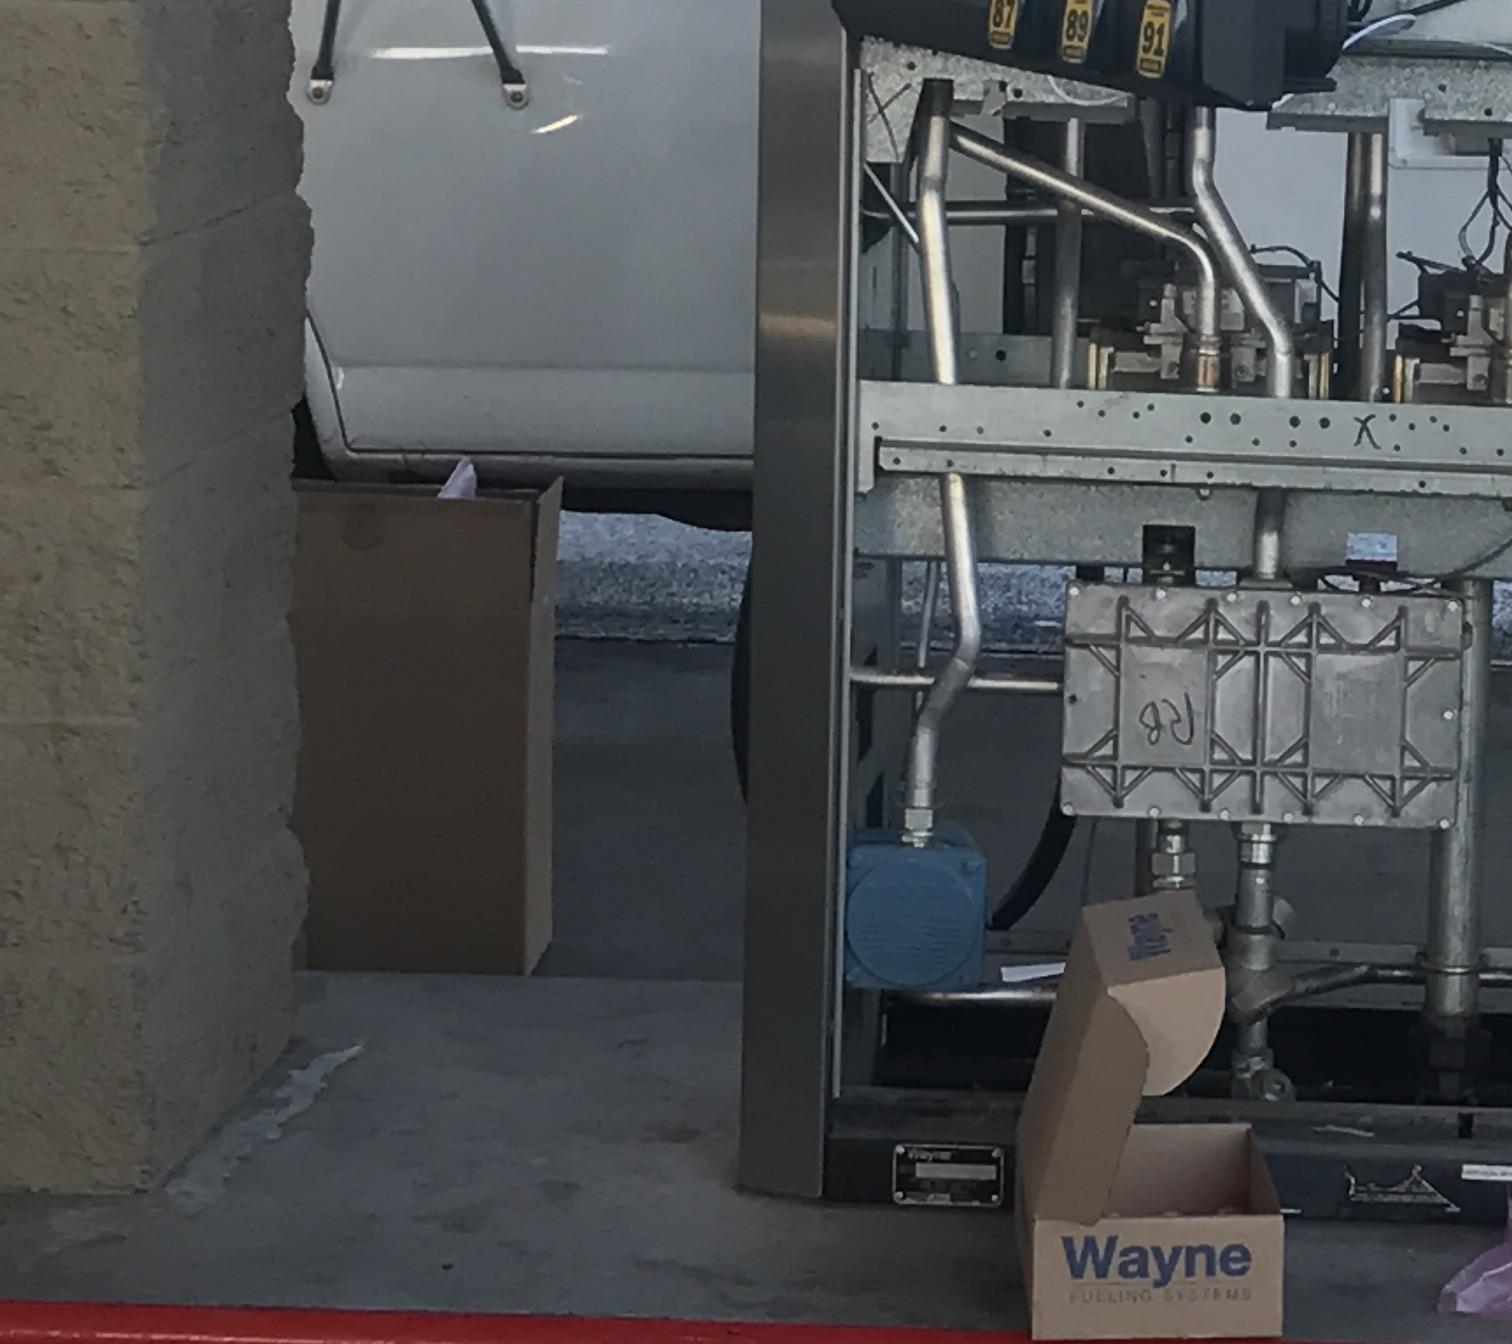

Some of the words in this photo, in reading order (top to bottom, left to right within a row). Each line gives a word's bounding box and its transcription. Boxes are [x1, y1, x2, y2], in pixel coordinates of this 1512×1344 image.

[1065, 9, 1090, 42] 89
[1142, 21, 1165, 56] 91
[1060, 1235, 1252, 1289] Wayne
